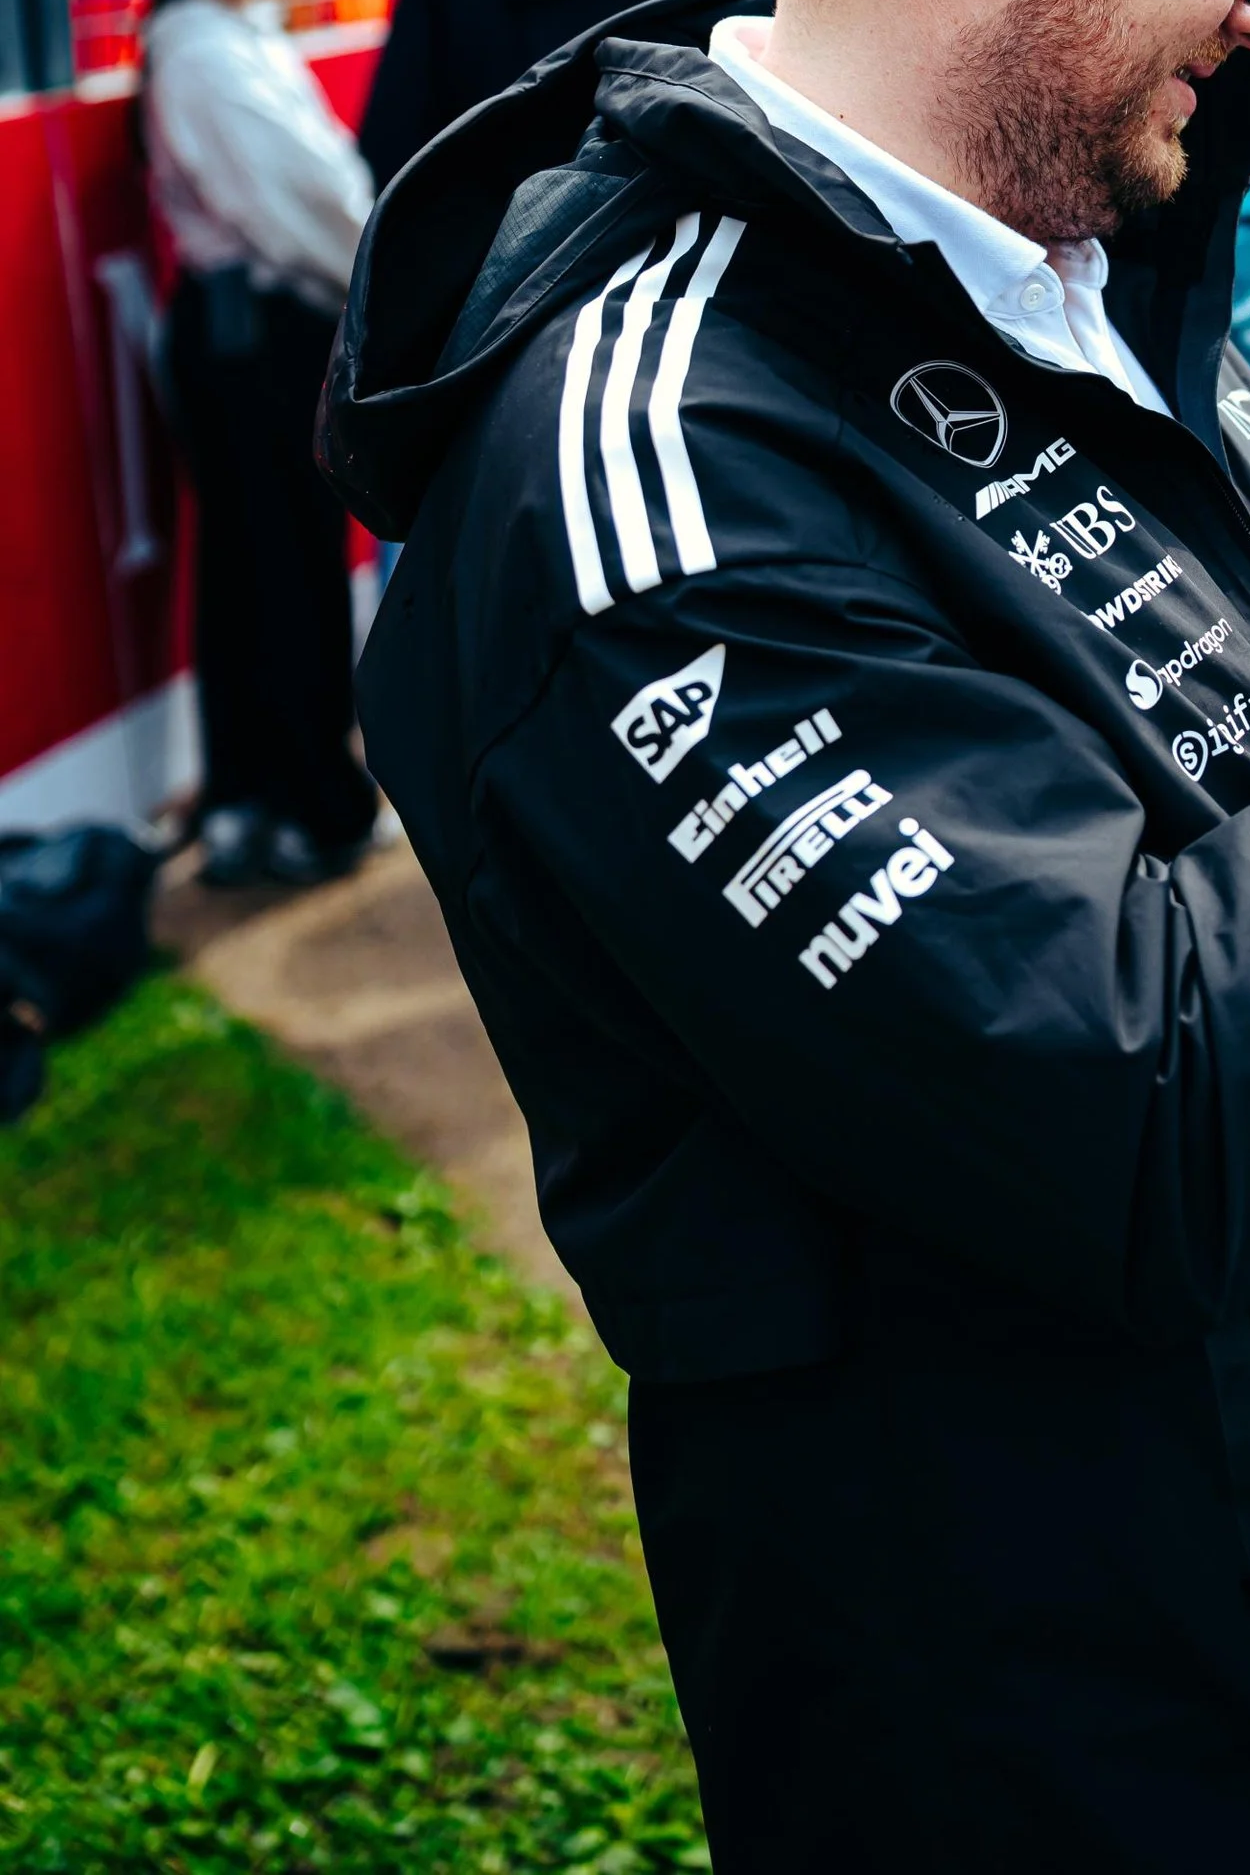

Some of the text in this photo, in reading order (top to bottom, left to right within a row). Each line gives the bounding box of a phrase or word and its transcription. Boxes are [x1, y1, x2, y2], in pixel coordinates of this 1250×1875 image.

[998, 437, 1077, 502] AMG
[1049, 485, 1137, 560] UBS
[627, 681, 713, 766] SAP
[667, 708, 842, 864] Einhell
[722, 769, 893, 928] PIRELLI
[799, 817, 955, 989] nuvei
